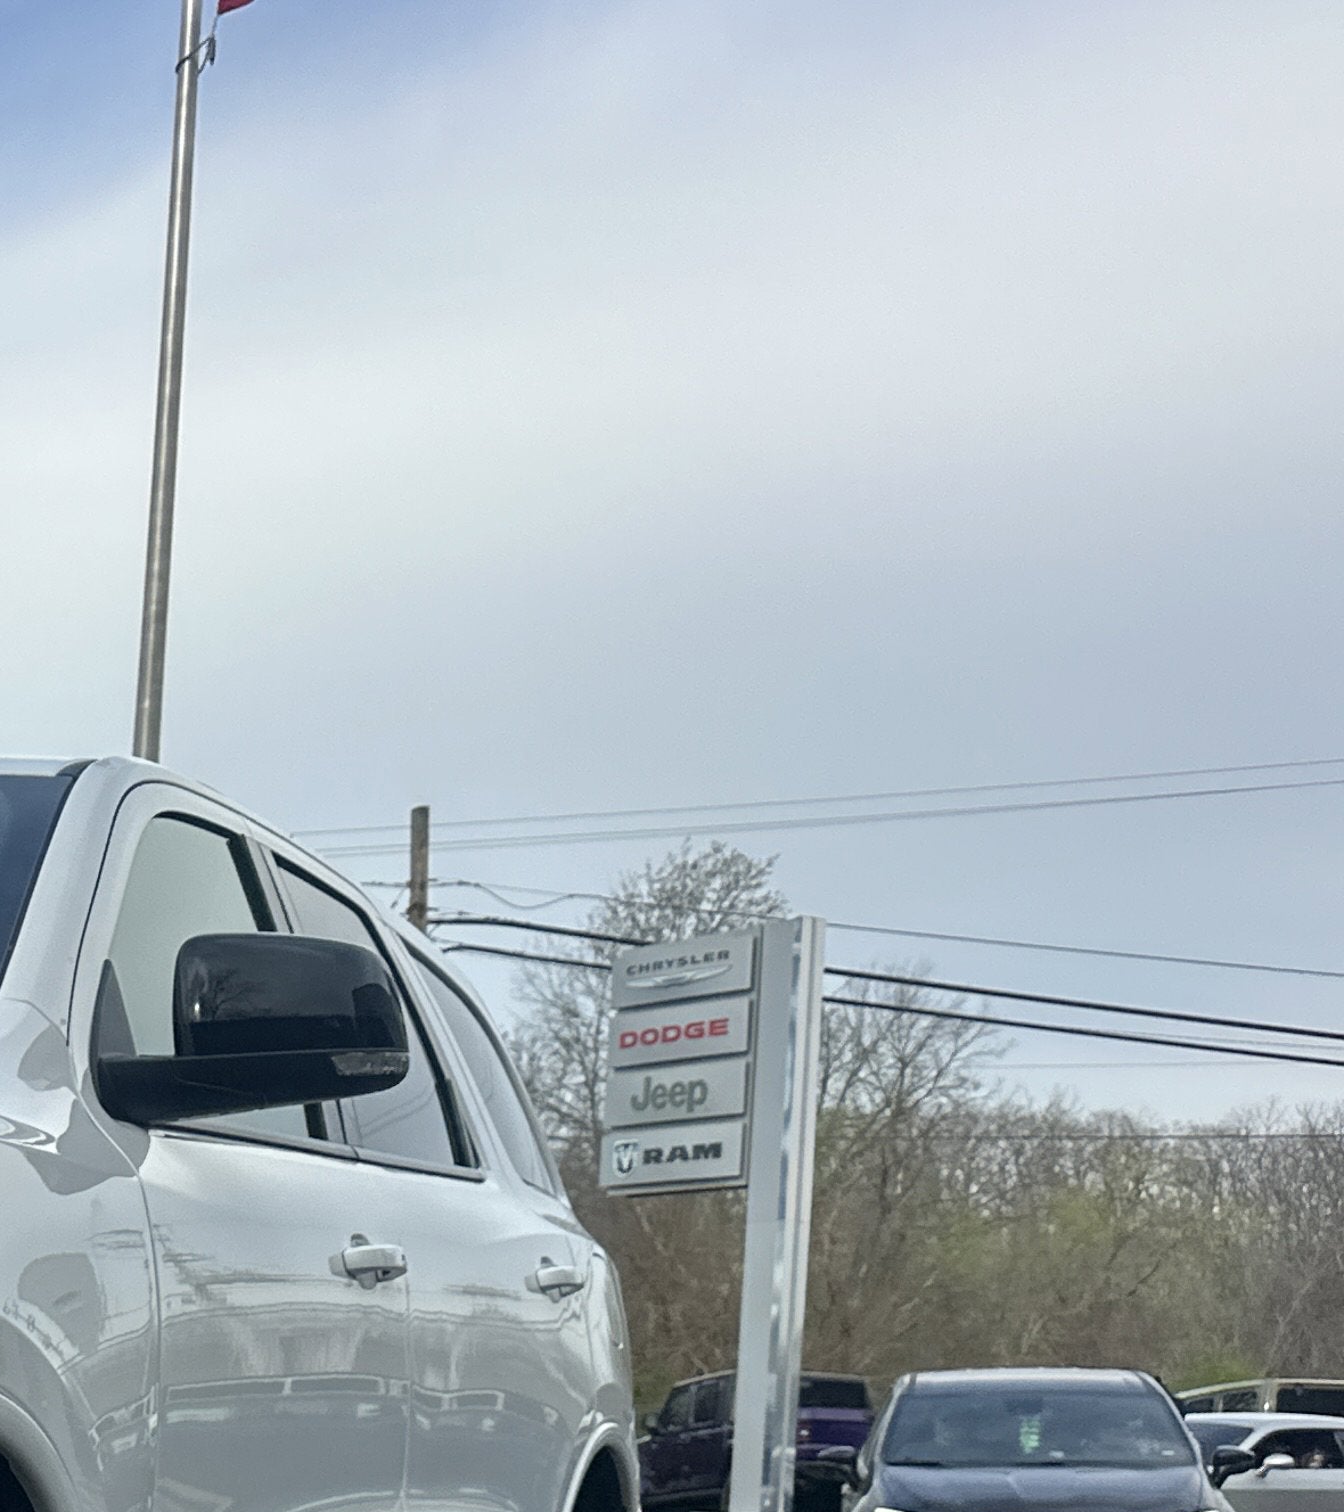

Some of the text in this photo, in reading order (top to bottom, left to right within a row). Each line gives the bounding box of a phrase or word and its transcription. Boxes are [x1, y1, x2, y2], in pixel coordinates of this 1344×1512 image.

[626, 949, 730, 977] CHRYSLER
[619, 1018, 730, 1049] DODGE
[630, 1076, 708, 1112] Jeep
[642, 1141, 723, 1165] RAM
